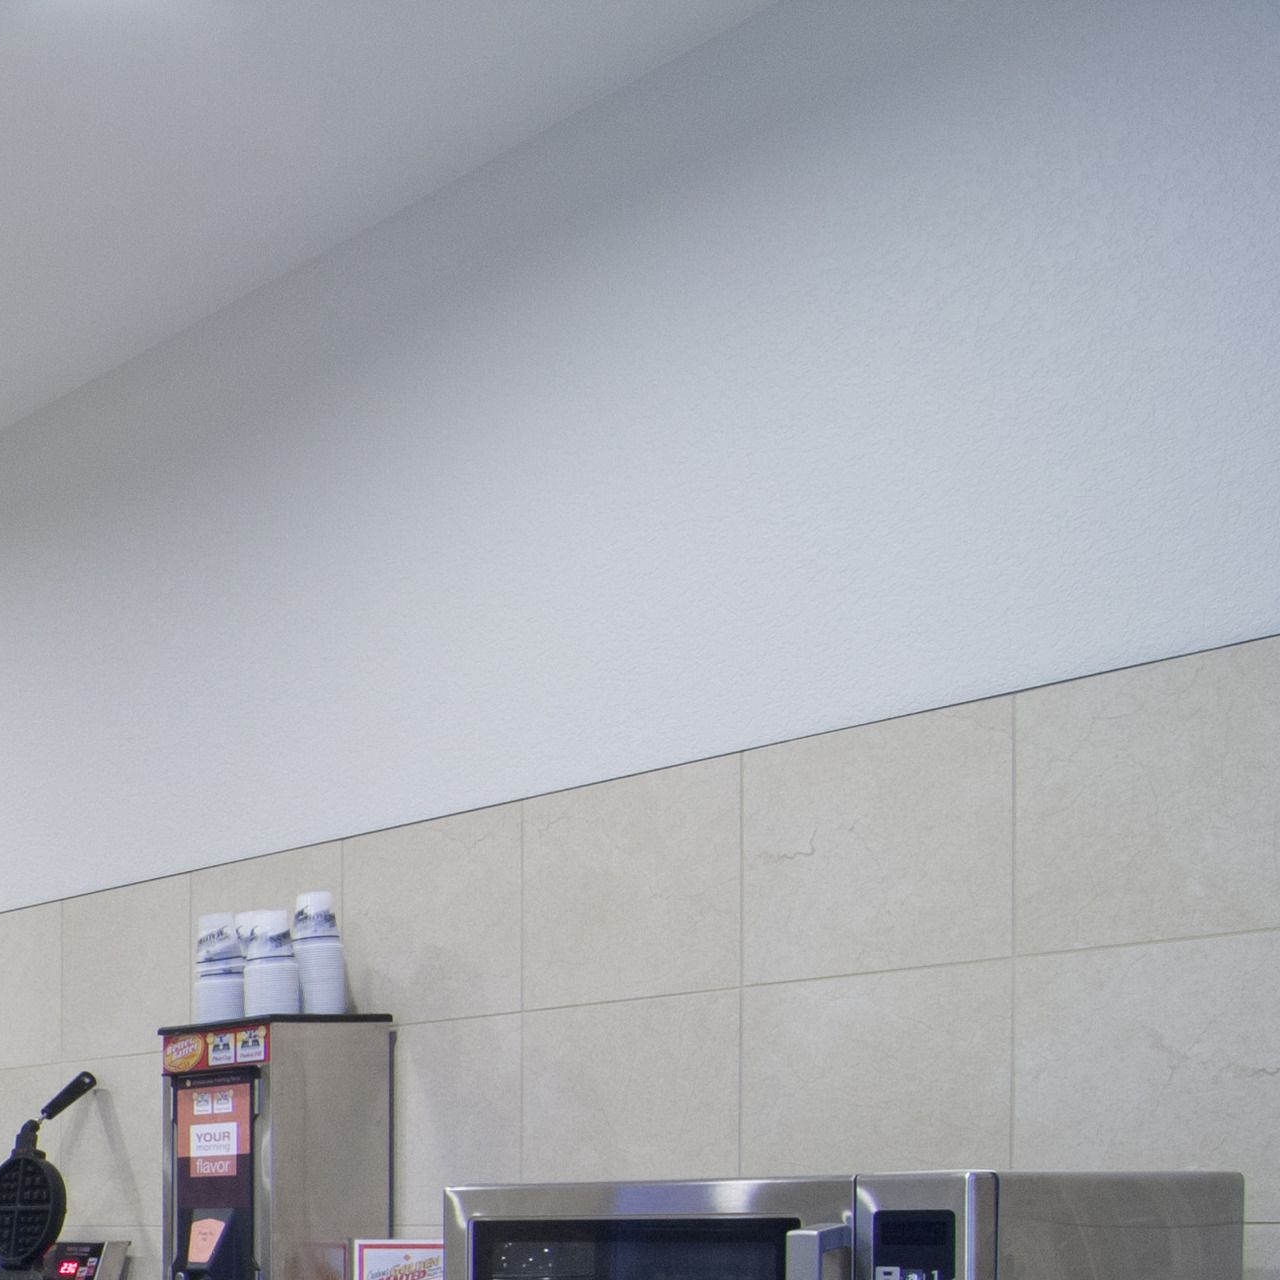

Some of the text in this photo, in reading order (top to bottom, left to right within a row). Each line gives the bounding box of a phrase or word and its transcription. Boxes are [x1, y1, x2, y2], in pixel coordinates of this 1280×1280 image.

[195, 1130, 231, 1143] YOUR
[195, 1141, 231, 1154] morning
[195, 1158, 231, 1174] flavor
